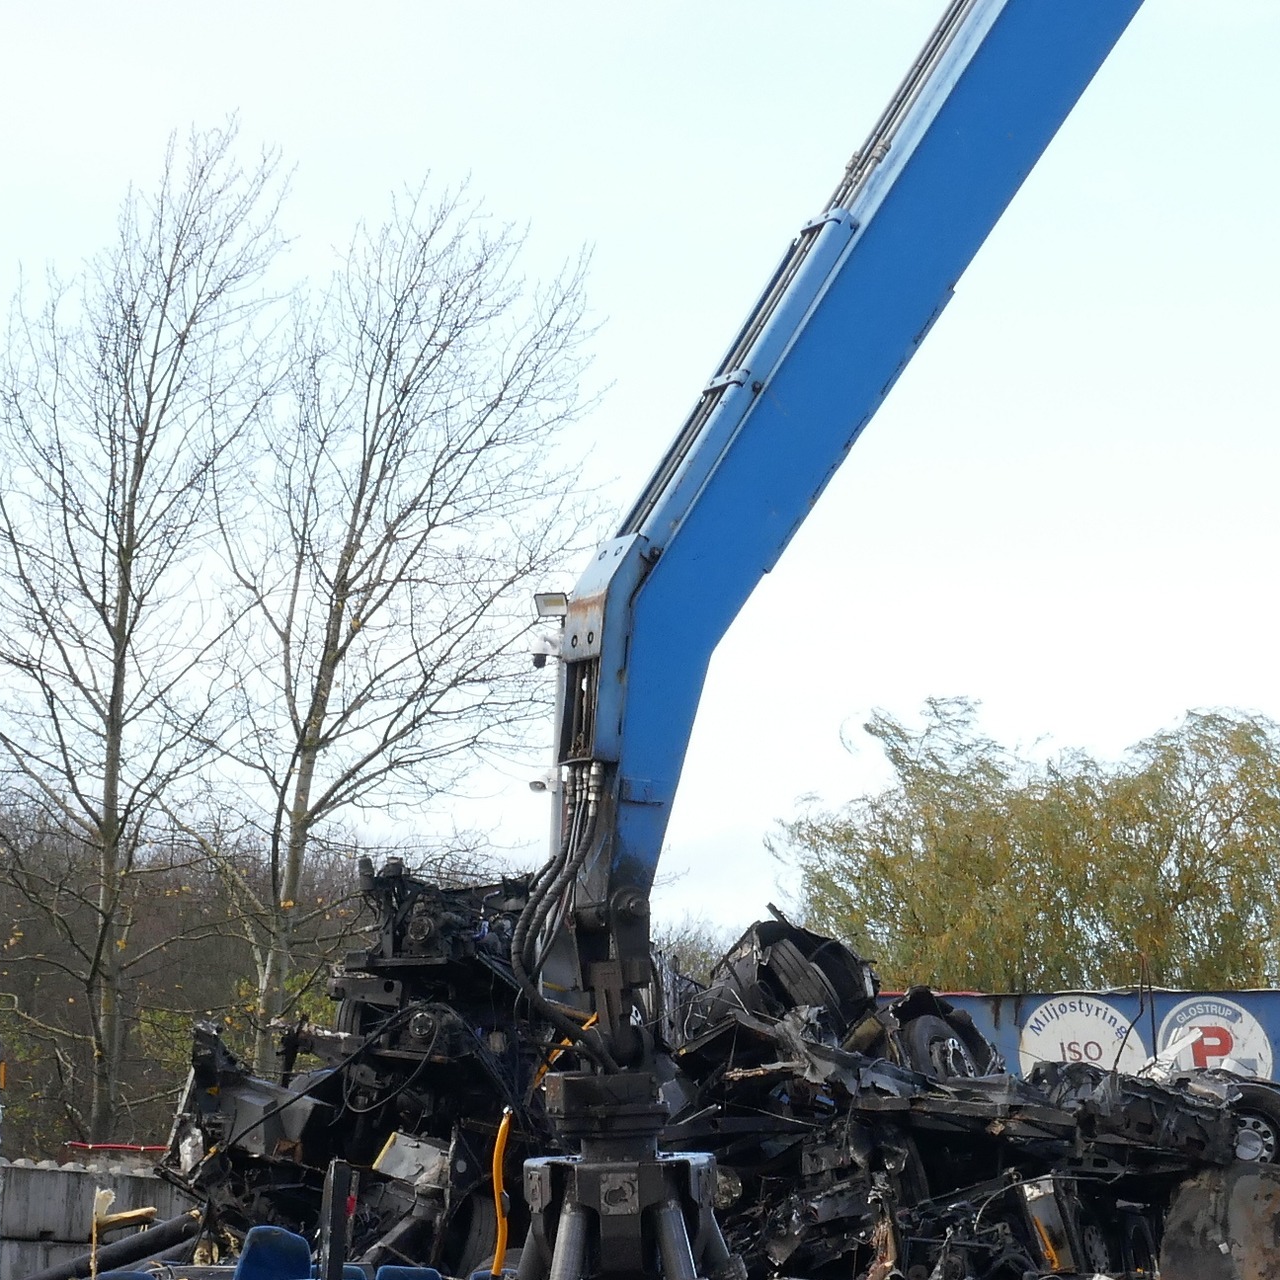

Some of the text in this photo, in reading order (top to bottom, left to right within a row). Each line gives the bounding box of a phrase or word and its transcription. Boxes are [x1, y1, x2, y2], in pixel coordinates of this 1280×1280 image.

[1029, 999, 1129, 1040] Miljøstyring
[1176, 1003, 1233, 1024] GLOSTRUP
[1059, 1041, 1103, 1062] ISO
